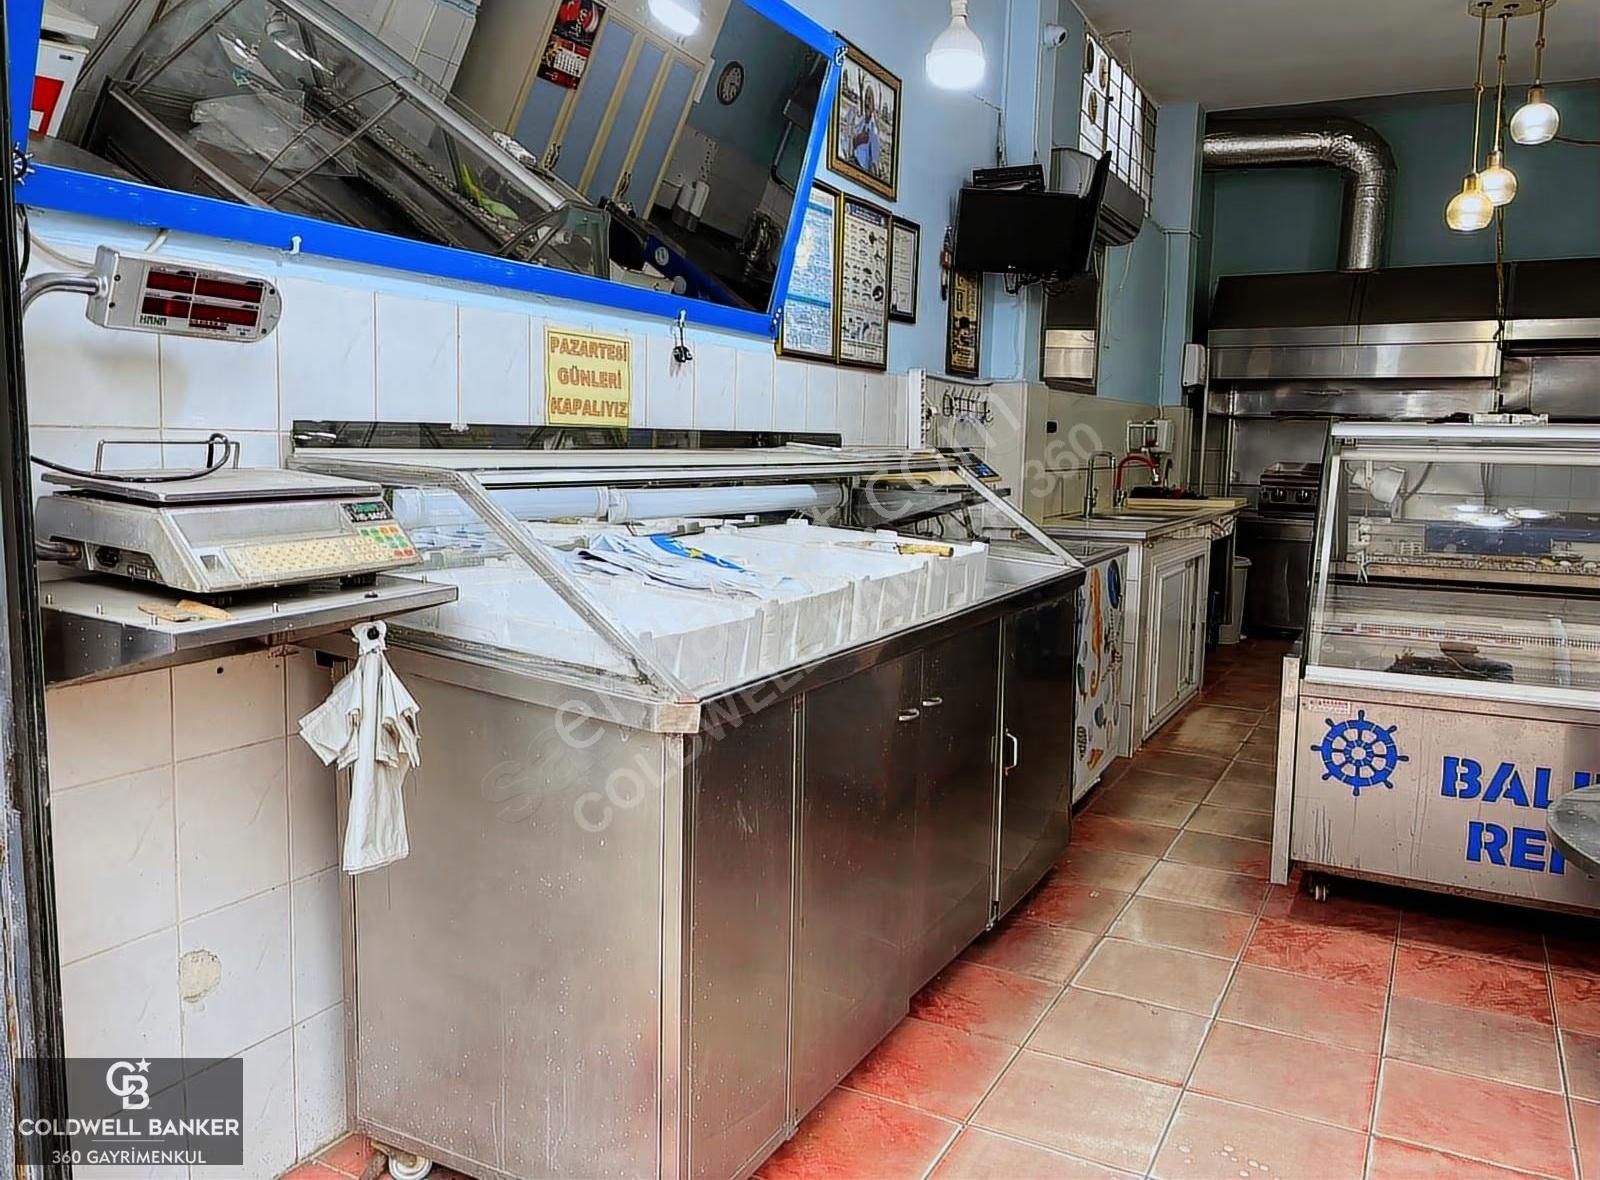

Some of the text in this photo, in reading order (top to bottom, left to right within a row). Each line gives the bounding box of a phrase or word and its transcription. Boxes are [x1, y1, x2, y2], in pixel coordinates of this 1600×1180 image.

[557, 365, 622, 389] GÜNLERİ
[551, 397, 628, 417] KAPALIYIZ
[1441, 756, 1600, 809] BAL
